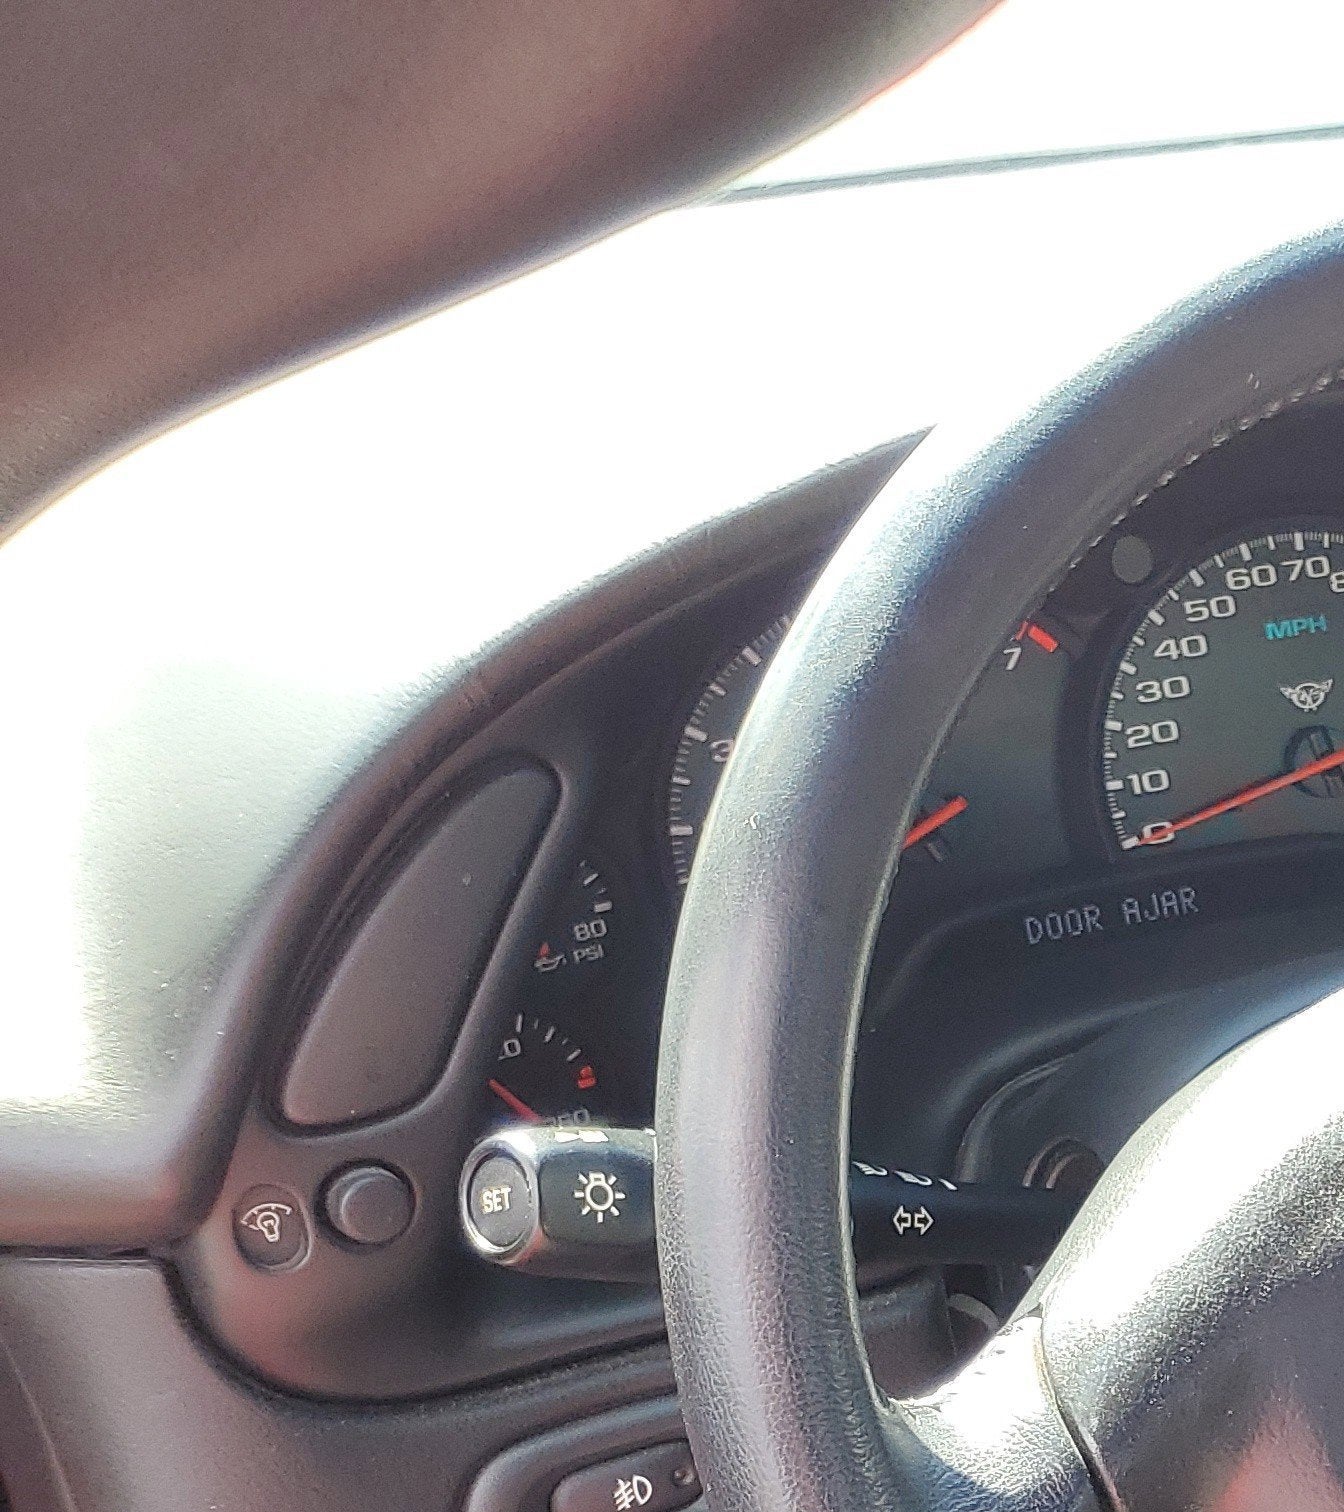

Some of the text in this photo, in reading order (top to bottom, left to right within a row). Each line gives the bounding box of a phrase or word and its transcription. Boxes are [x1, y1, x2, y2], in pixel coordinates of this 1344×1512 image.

[1225, 564, 1278, 590] 60
[1279, 555, 1331, 582] 70
[1183, 595, 1237, 623] 50
[1263, 615, 1328, 641] MPH
[1003, 647, 1022, 671] 7
[1153, 634, 1209, 661] 40
[1135, 675, 1191, 703] 30
[1125, 720, 1180, 749] 20
[1127, 769, 1170, 795] 10
[1023, 887, 1200, 946] DOOR AJAR
[573, 919, 607, 942] 80
[573, 944, 605, 963] PSI
[482, 1187, 512, 1213] SET
